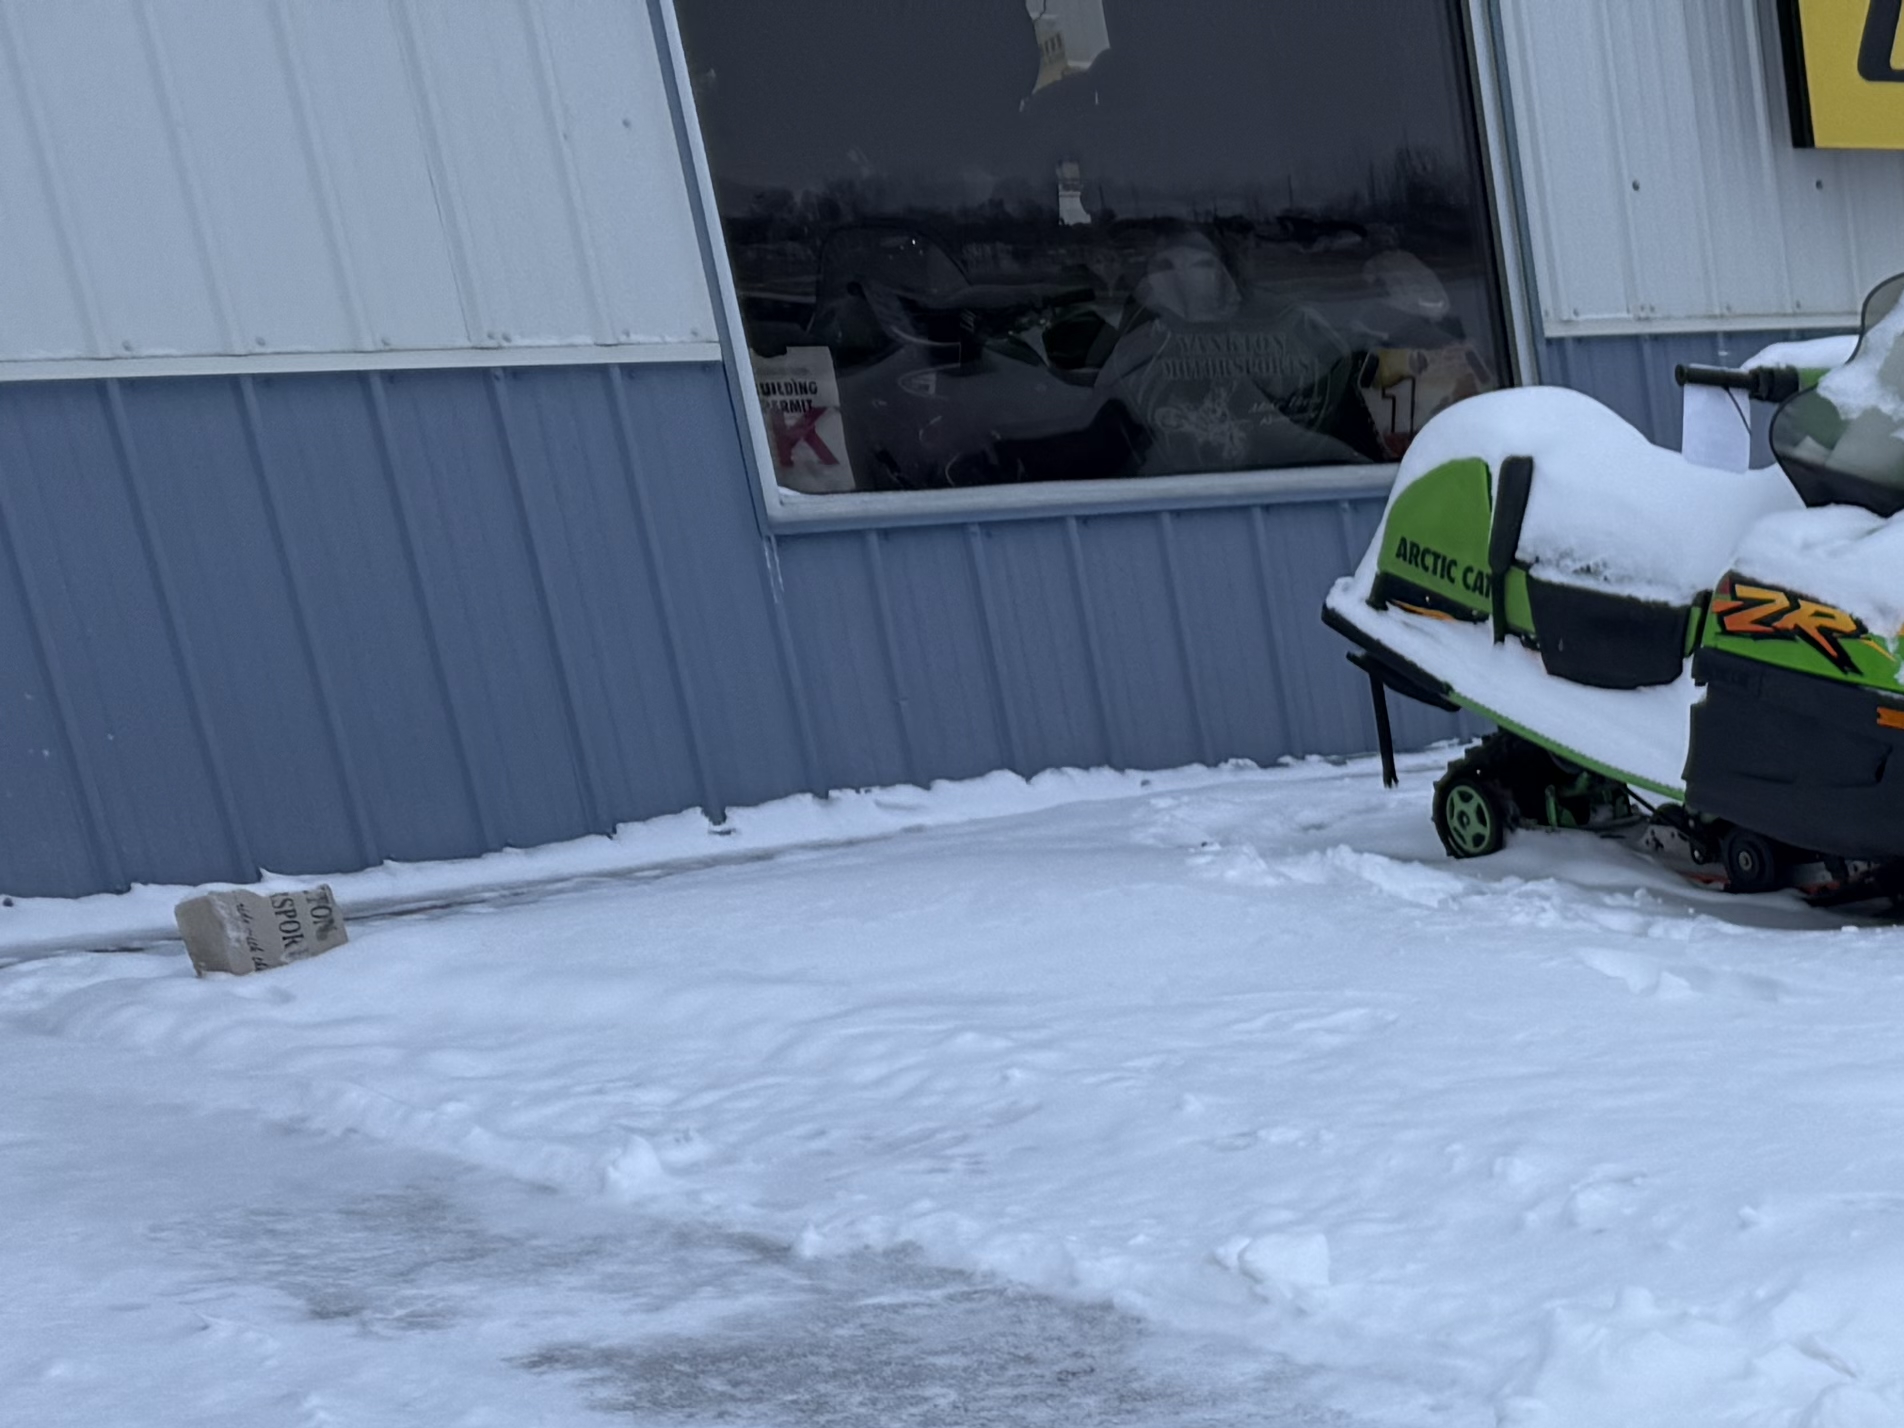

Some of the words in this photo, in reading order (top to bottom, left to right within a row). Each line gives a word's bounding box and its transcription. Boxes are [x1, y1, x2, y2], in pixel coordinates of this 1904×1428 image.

[758, 380, 818, 396] UILDING
[1395, 536, 1458, 585] ARCTIC
[1711, 582, 1864, 672] ZR
